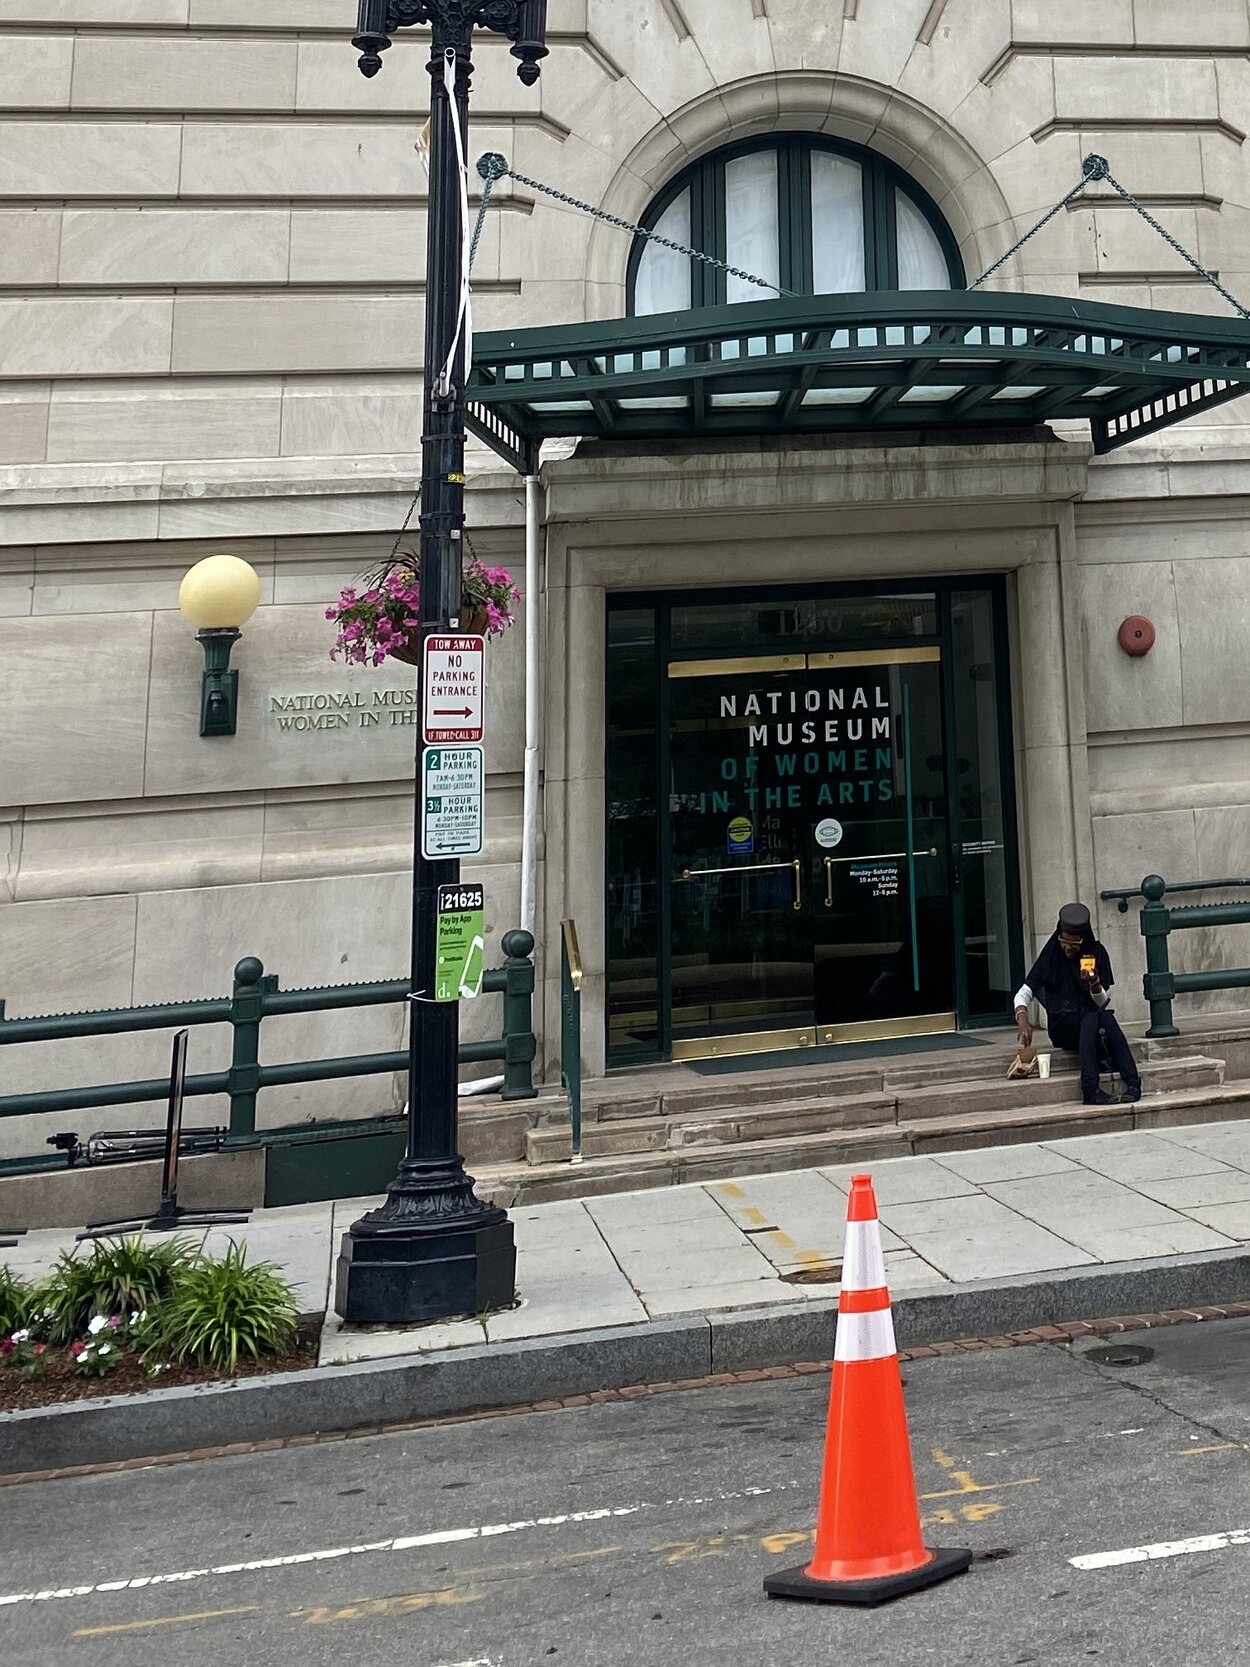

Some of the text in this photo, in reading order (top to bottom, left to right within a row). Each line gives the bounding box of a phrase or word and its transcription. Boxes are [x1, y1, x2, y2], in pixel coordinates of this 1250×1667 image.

[434, 639, 476, 650] TOW AWAY
[447, 654, 462, 667] NO
[432, 671, 475, 682] PARKING
[431, 686, 477, 697] ENTRANCE
[270, 690, 418, 712] NATIONAL MUS
[720, 686, 889, 718] NATIONAL
[278, 709, 418, 731] WOMEN IN TH
[428, 731, 434, 740] IF
[471, 730, 480, 739] 311
[749, 717, 890, 747] MUSEUM
[444, 751, 473, 761] HOUR
[430, 755, 438, 769] 2
[443, 761, 477, 770] PARKING
[721, 747, 891, 780] OF WOMEN
[448, 797, 472, 805] HOUR
[700, 778, 893, 814] IN THE ARTS
[443, 805, 478, 814] PARKING
[440, 914, 472, 926] Pay by App
[440, 926, 462, 936] Parking
